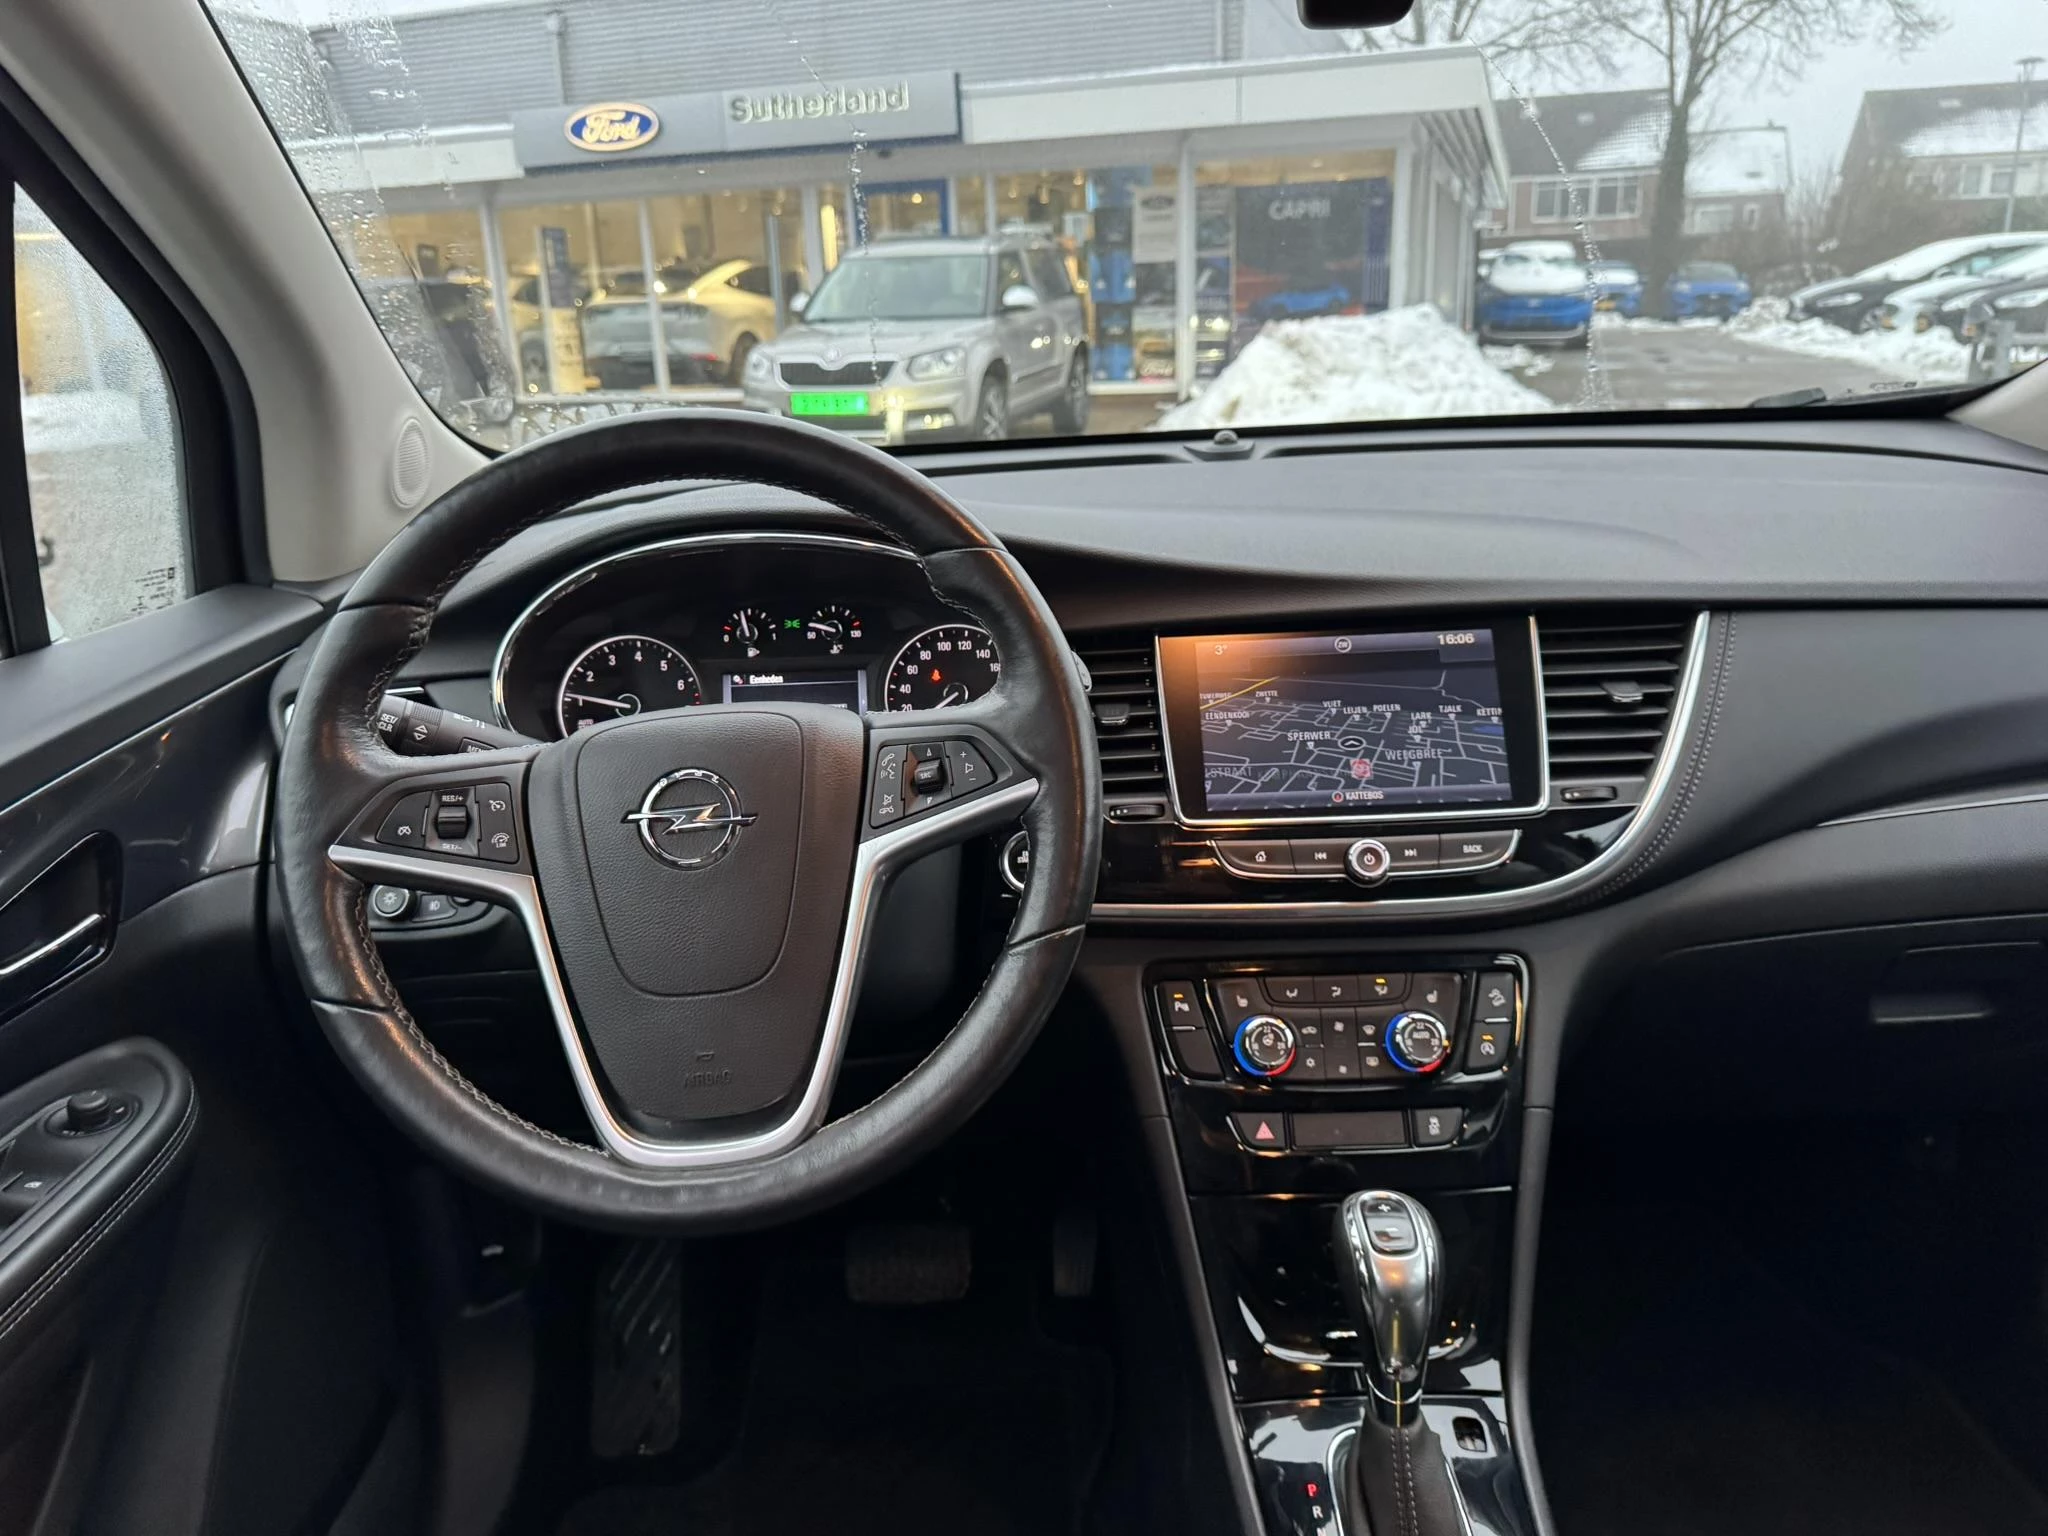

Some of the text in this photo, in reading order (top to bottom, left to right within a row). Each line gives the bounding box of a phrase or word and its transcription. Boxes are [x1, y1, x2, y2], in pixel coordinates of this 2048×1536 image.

[730, 80, 910, 124] Sutherland
[1268, 199, 1331, 220] CAPRI
[723, 635, 730, 643] 0
[772, 633, 777, 641] 1
[851, 630, 862, 638] 130
[1437, 633, 1475, 646] 16:06
[937, 642, 951, 651] 100
[957, 641, 972, 650] 120
[634, 651, 643, 662] 4
[920, 651, 932, 660] 80
[976, 649, 991, 659] 140
[608, 655, 616, 666] 3
[660, 660, 668, 671] 5
[907, 665, 918, 675] 60
[586, 671, 595, 682] 2
[677, 679, 685, 690] 6
[899, 684, 911, 694] 40
[901, 704, 913, 712] 20
[1372, 703, 1401, 712] POELEN
[1438, 704, 1462, 713] TJALK
[1408, 725, 1423, 734] JOL
[1287, 731, 1332, 741] SPERWER
[1385, 749, 1443, 761] WEEGBREE
[1345, 791, 1384, 801] KATTEBOS
[1463, 844, 1483, 853] BACK
[1307, 1484, 1317, 1497] P
[1312, 1505, 1324, 1519] R
